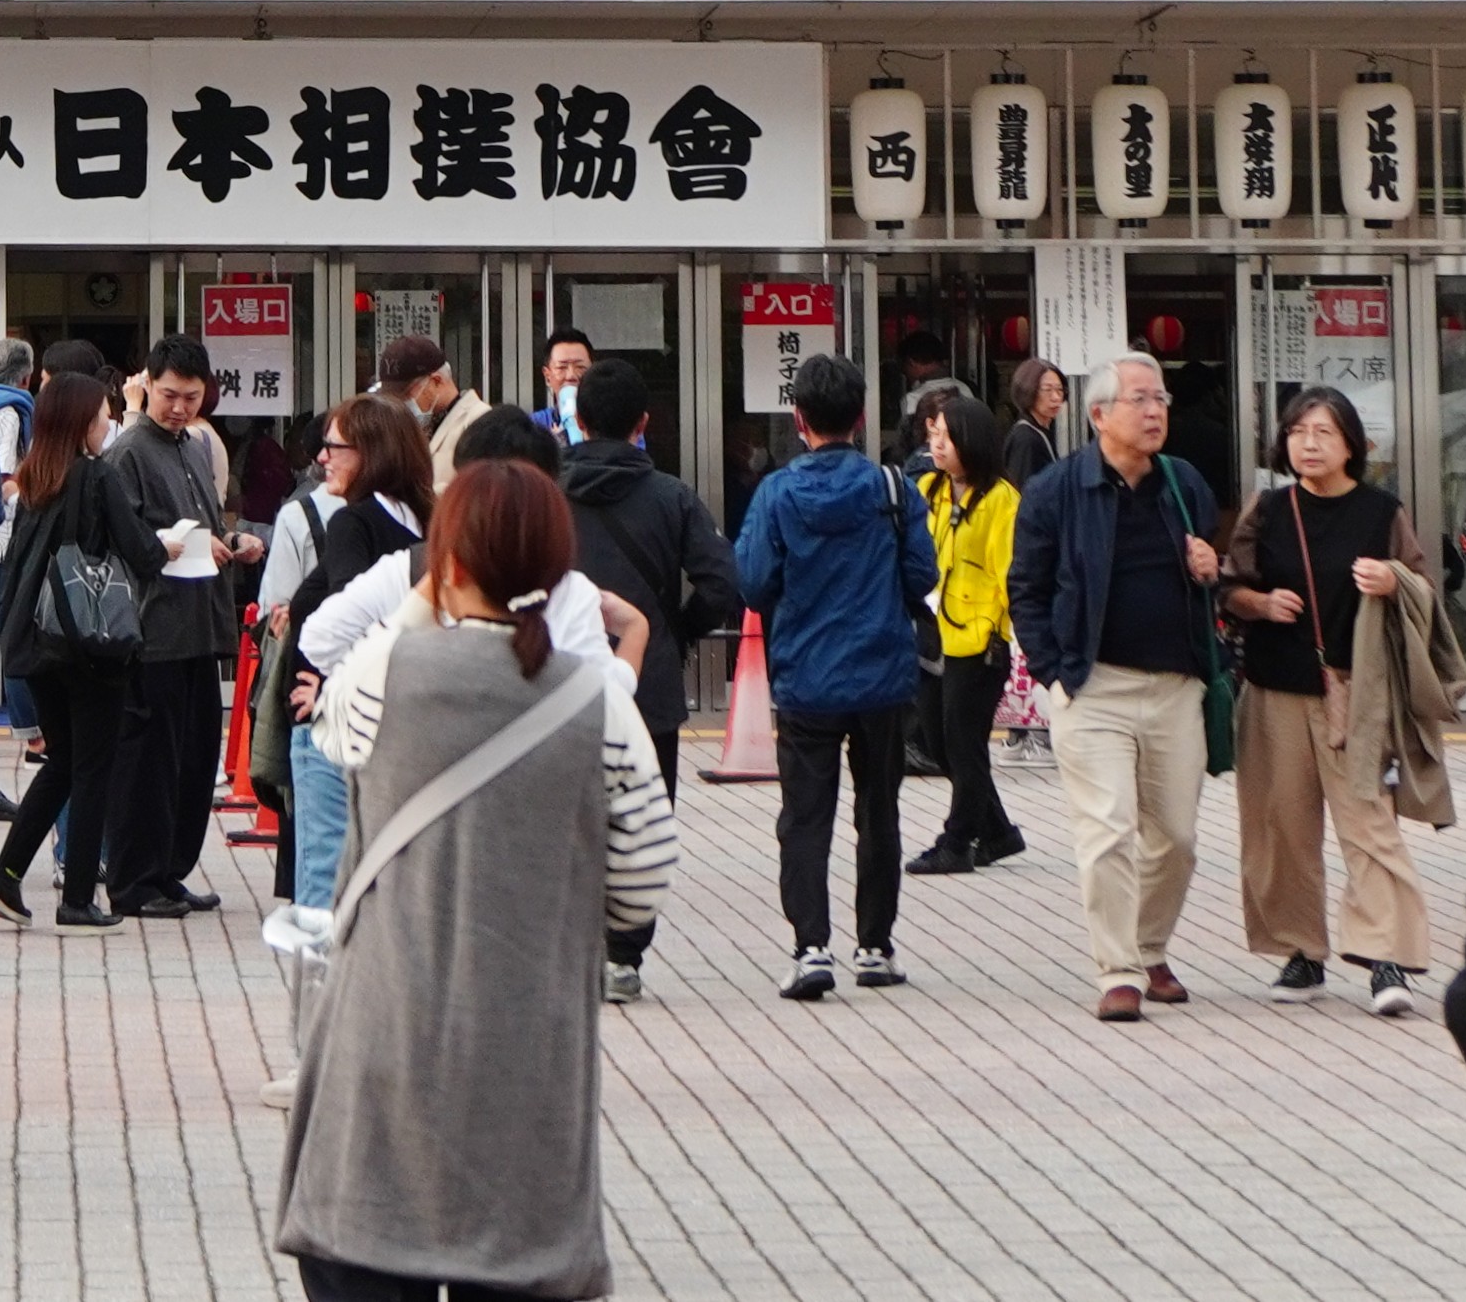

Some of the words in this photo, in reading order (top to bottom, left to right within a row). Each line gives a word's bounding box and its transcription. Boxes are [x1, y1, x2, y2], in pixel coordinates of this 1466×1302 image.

[52, 83, 763, 204] 日本相撲協會
[867, 131, 916, 182] 西
[1120, 103, 1155, 198] 大の里
[1367, 104, 1399, 202] 正代
[207, 298, 286, 324] 入場口
[764, 293, 813, 315] 入口
[777, 329, 801, 406] 椅子席
